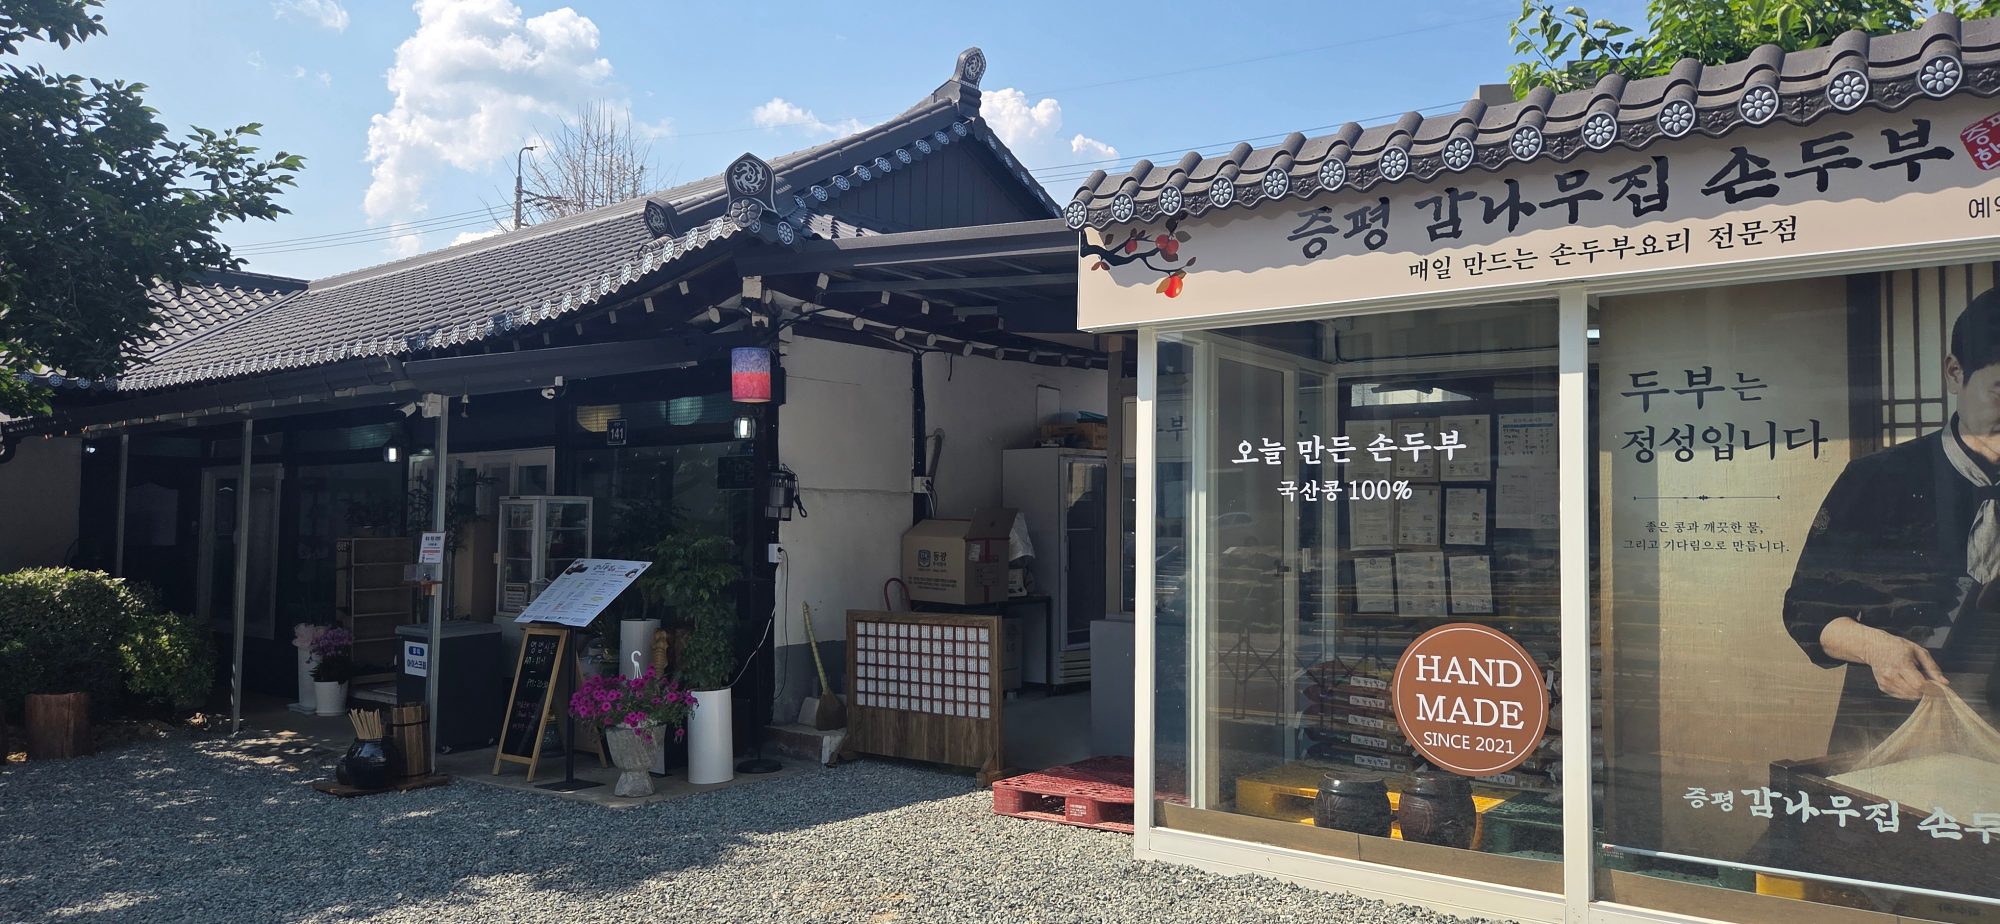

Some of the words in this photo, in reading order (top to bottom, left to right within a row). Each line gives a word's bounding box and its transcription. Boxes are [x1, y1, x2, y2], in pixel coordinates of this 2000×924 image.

[1286, 197, 1390, 259] 증평
[1414, 154, 1670, 243] 감나무집
[1700, 118, 1955, 205] 손두부
[1408, 255, 1451, 282] 매일
[1462, 247, 1539, 277] 만드는
[1548, 227, 1691, 266] 손두부요리
[1706, 215, 1798, 250] 전문점
[1620, 366, 1768, 413] 두부는
[610, 428, 624, 440] 141
[1231, 437, 1287, 466] 오늘
[1296, 433, 1357, 466] 만든
[1365, 429, 1468, 463] 손두부
[1620, 418, 1829, 464] 정성입니다
[1276, 479, 1343, 502] 국산콩
[1349, 479, 1413, 501] 100%
[1623, 539, 1659, 551] 그리고
[1664, 539, 1727, 552] 기다림으로
[1732, 539, 1790, 553] 만듭니다.
[1645, 520, 1670, 534] 좋은
[1674, 520, 1700, 534] 콩과
[1703, 520, 1743, 534] 깨끗한
[1747, 521, 1764, 535] 물,
[1415, 653, 1523, 688] HAND
[1416, 693, 1526, 730] MADE
[1423, 731, 1471, 751] SINCE
[1475, 736, 1515, 755] 2021
[1683, 786, 1735, 812] 증평
[1741, 786, 1900, 834] 감나무집
